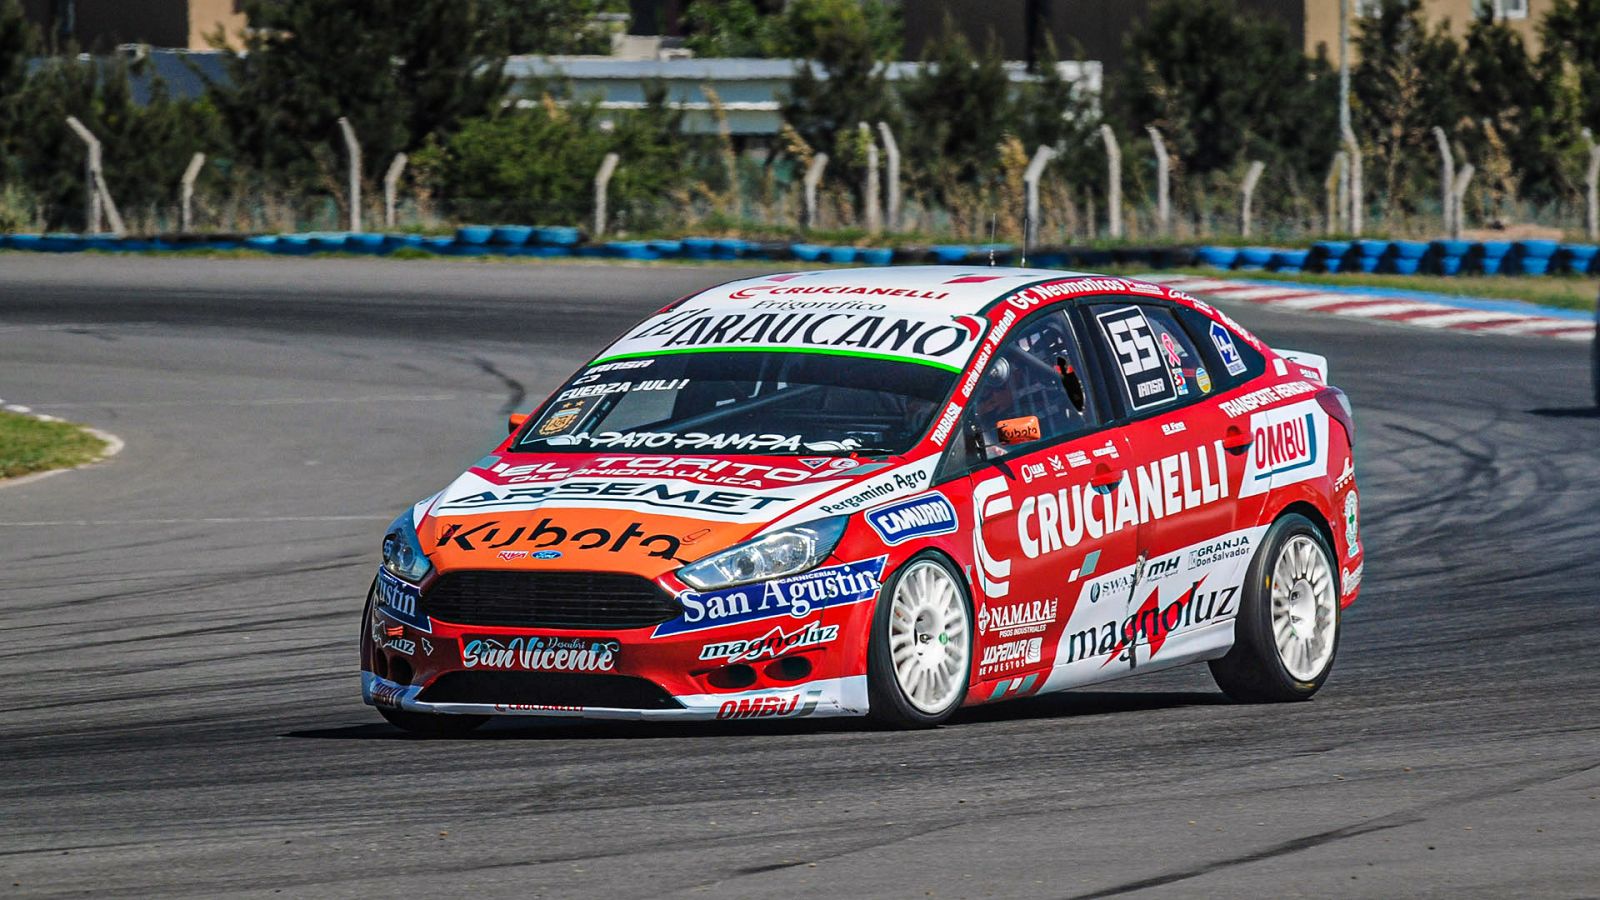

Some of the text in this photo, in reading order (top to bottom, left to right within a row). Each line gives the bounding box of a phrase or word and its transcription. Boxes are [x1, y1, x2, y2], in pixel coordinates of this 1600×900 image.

[769, 286, 949, 300] CRUCIANELLI
[1007, 288, 1039, 310] GC
[661, 313, 968, 357] ARAUCANO
[1107, 315, 1161, 376] 55
[558, 381, 632, 400] FUERZA
[1218, 386, 1281, 418] TRANSPORTE
[590, 432, 802, 451] PATO PAMPA
[999, 425, 1038, 442] Kubota
[1255, 417, 1306, 468] OMBU
[595, 457, 813, 482] TORITO
[450, 482, 797, 510] ARSEMET
[820, 469, 927, 514] Pergamino Agro
[1018, 440, 1228, 559] CRUCIANELLI
[877, 501, 951, 534] CAMURRI
[436, 518, 682, 561] Kubota
[1197, 536, 1249, 557] GRANJA
[1196, 547, 1250, 568] Don Salvador
[378, 580, 416, 617] ustin
[681, 590, 752, 622] San
[989, 599, 1052, 628] NAMARA
[999, 628, 1013, 638] PISOS
[1067, 581, 1239, 662] magnoluz
[463, 637, 617, 671] San Vicente
[701, 622, 838, 658] magnoluz
[979, 659, 1025, 676] REPUESTOS
[716, 694, 800, 719] OMBU
